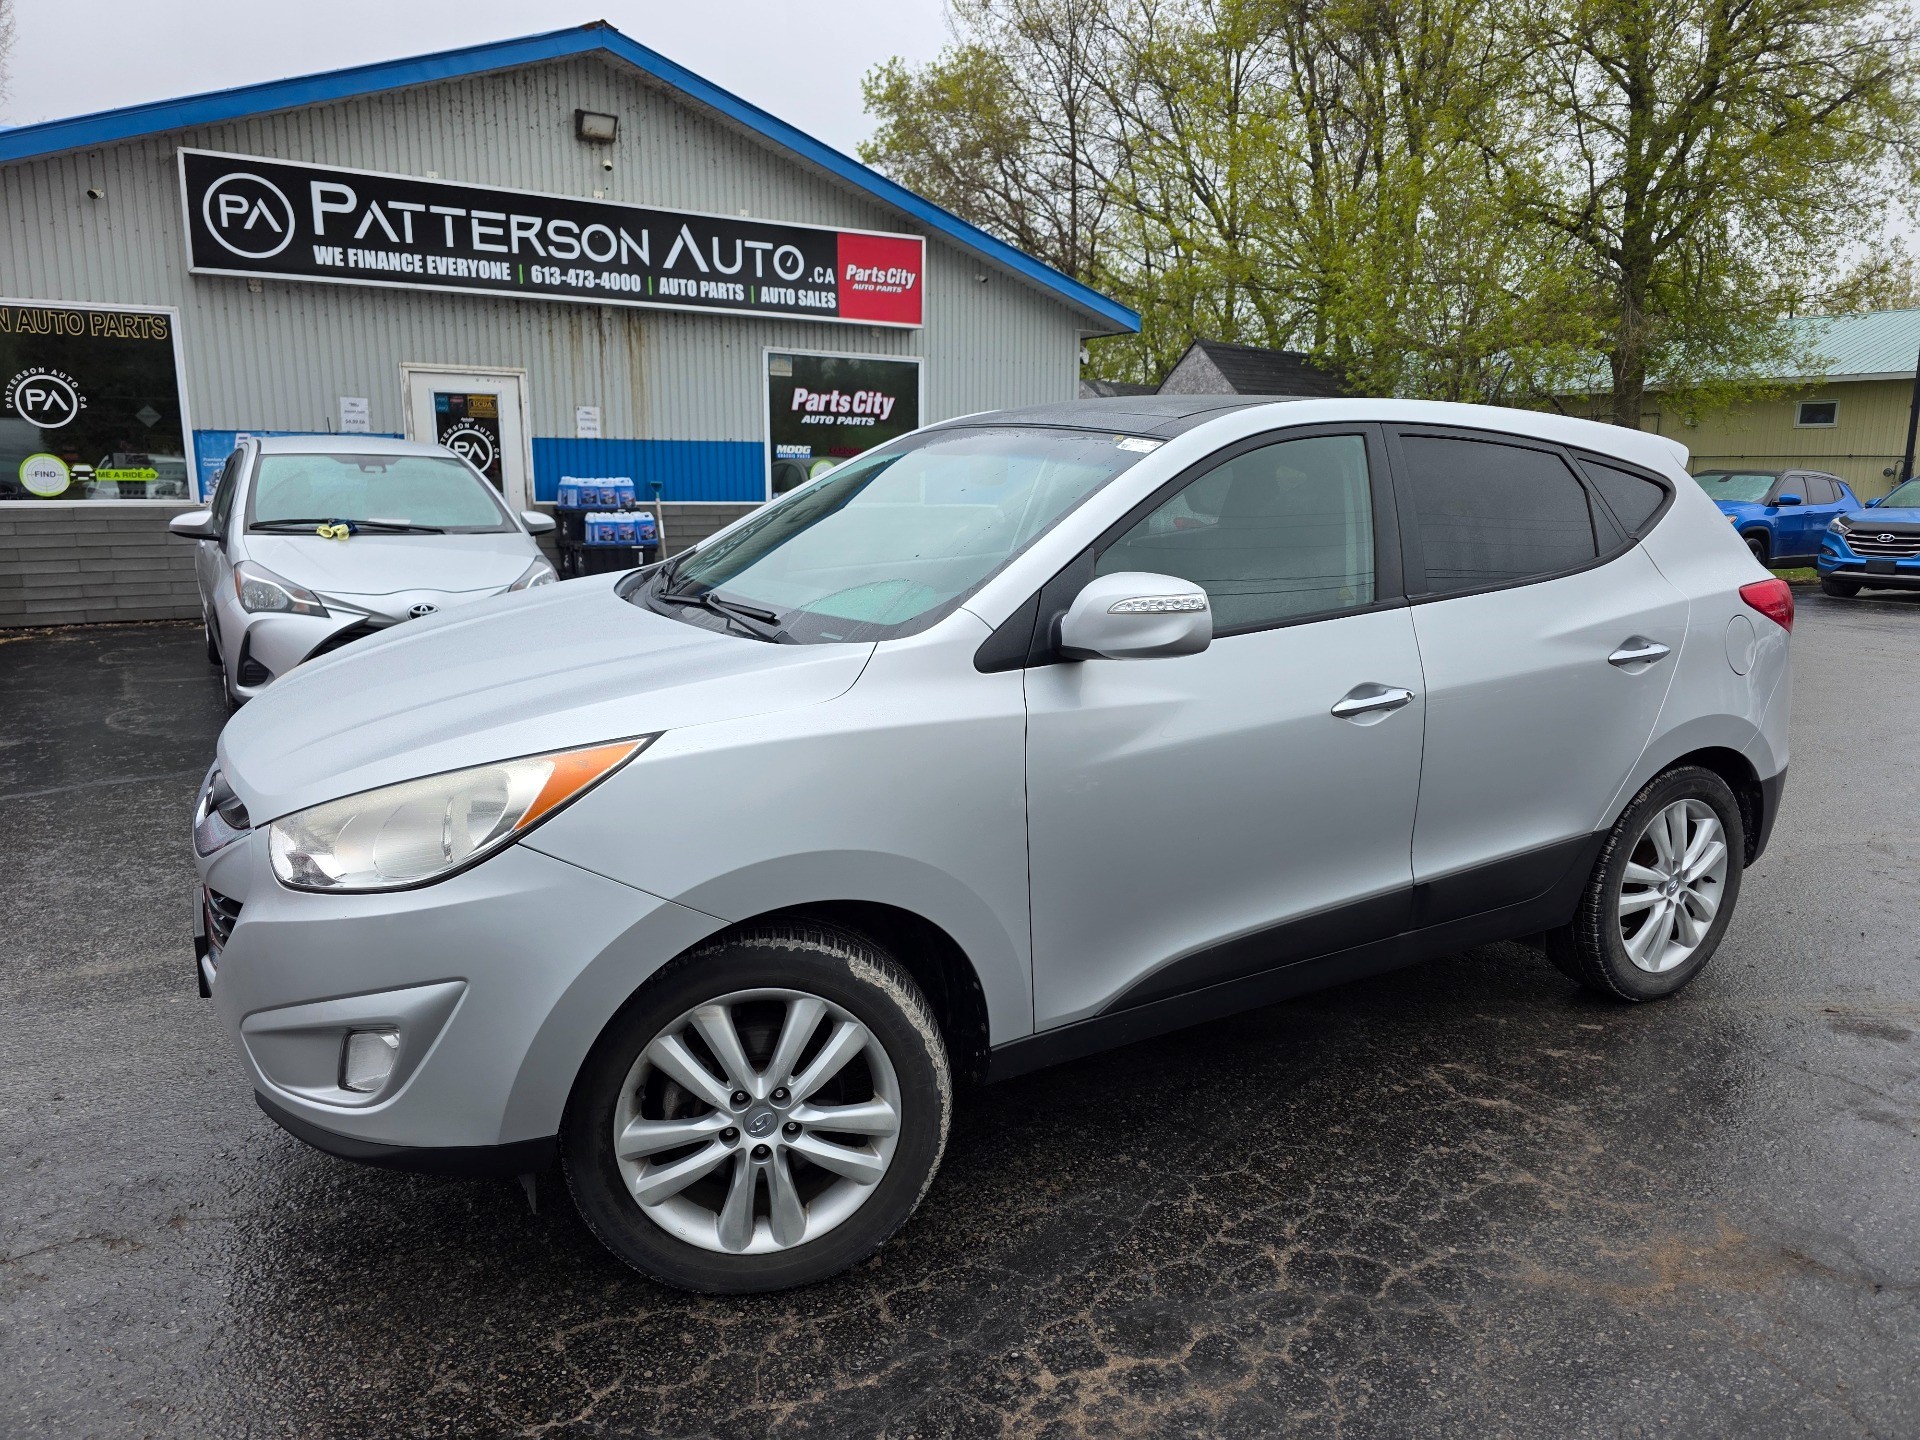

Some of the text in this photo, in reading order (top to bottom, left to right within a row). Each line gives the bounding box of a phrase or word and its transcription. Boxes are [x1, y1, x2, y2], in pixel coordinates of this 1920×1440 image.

[218, 193, 283, 233] PA
[310, 180, 650, 267] PATTERSON
[313, 244, 837, 309] WE FINANCE EVERYONE 613-473-4000 AUTO PARTS AUTO SALES
[852, 283, 903, 293] AUTO PARTS
[16, 308, 85, 336] AUTO
[89, 312, 168, 340] PARTS
[5, 367, 46, 409] PATTERSON
[25, 388, 70, 411] PA
[801, 415, 876, 426] AUTO PARTS
[440, 422, 470, 443] TERSON
[776, 444, 812, 454] MOOG
[98, 471, 112, 479] ME
[114, 471, 121, 479] A
